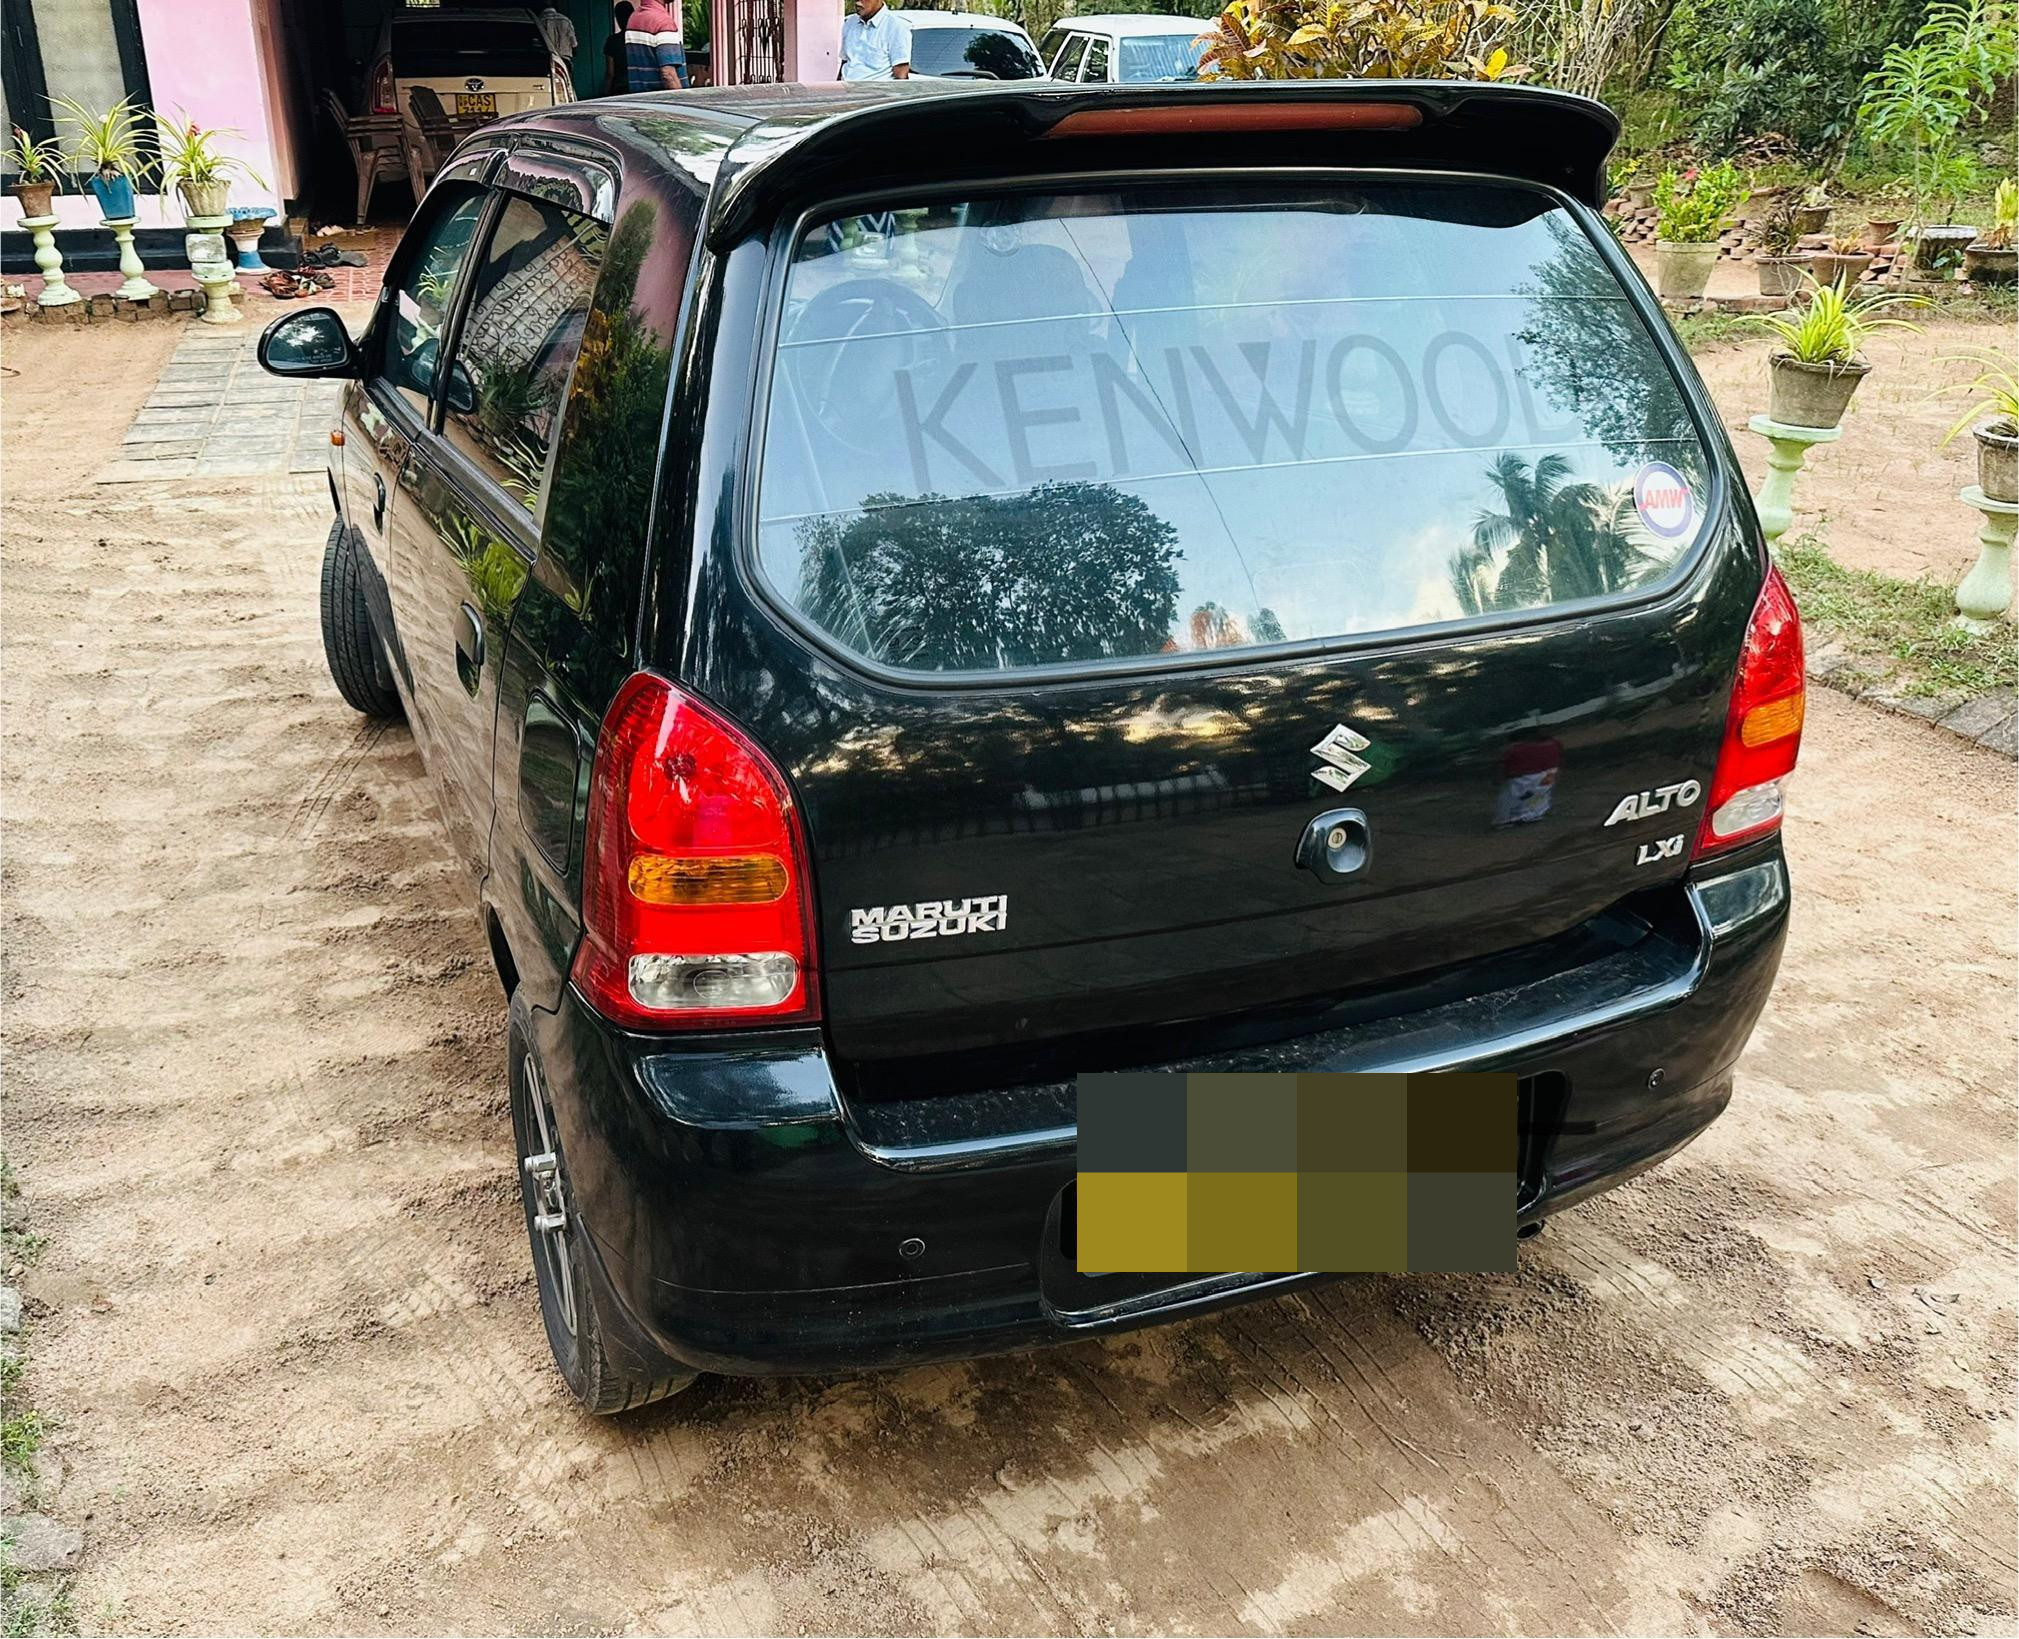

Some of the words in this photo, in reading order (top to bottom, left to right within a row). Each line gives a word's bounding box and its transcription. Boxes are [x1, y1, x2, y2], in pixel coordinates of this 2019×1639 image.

[468, 94, 492, 107] CAS
[1644, 487, 1684, 510] AMW
[1603, 779, 1701, 827] ALTO
[850, 894, 1008, 927] MARUTI
[850, 912, 1008, 944] SUZUKI
